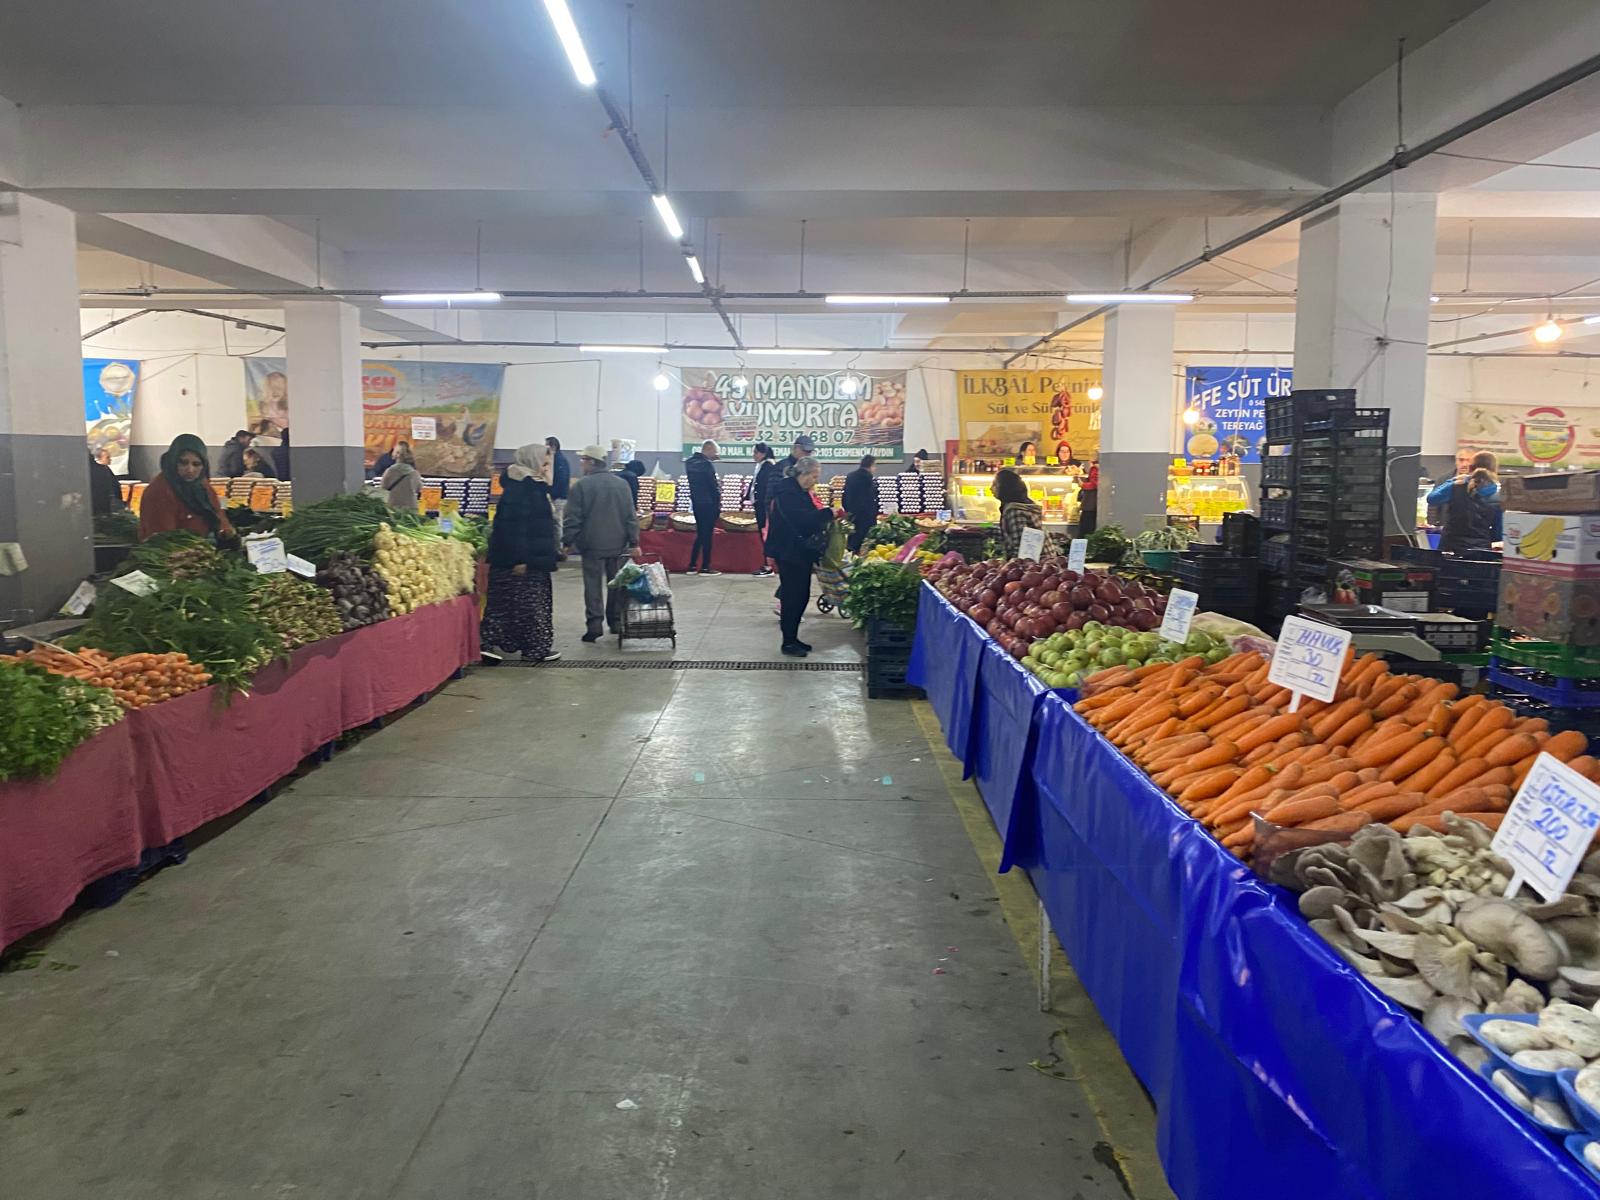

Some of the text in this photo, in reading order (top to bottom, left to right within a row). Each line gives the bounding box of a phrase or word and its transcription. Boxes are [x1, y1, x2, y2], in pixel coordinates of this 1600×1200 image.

[1227, 374, 1262, 401] SÜT
[1015, 404, 1028, 414] ve
[833, 430, 853, 442] 07
[1534, 806, 1569, 841] 200
